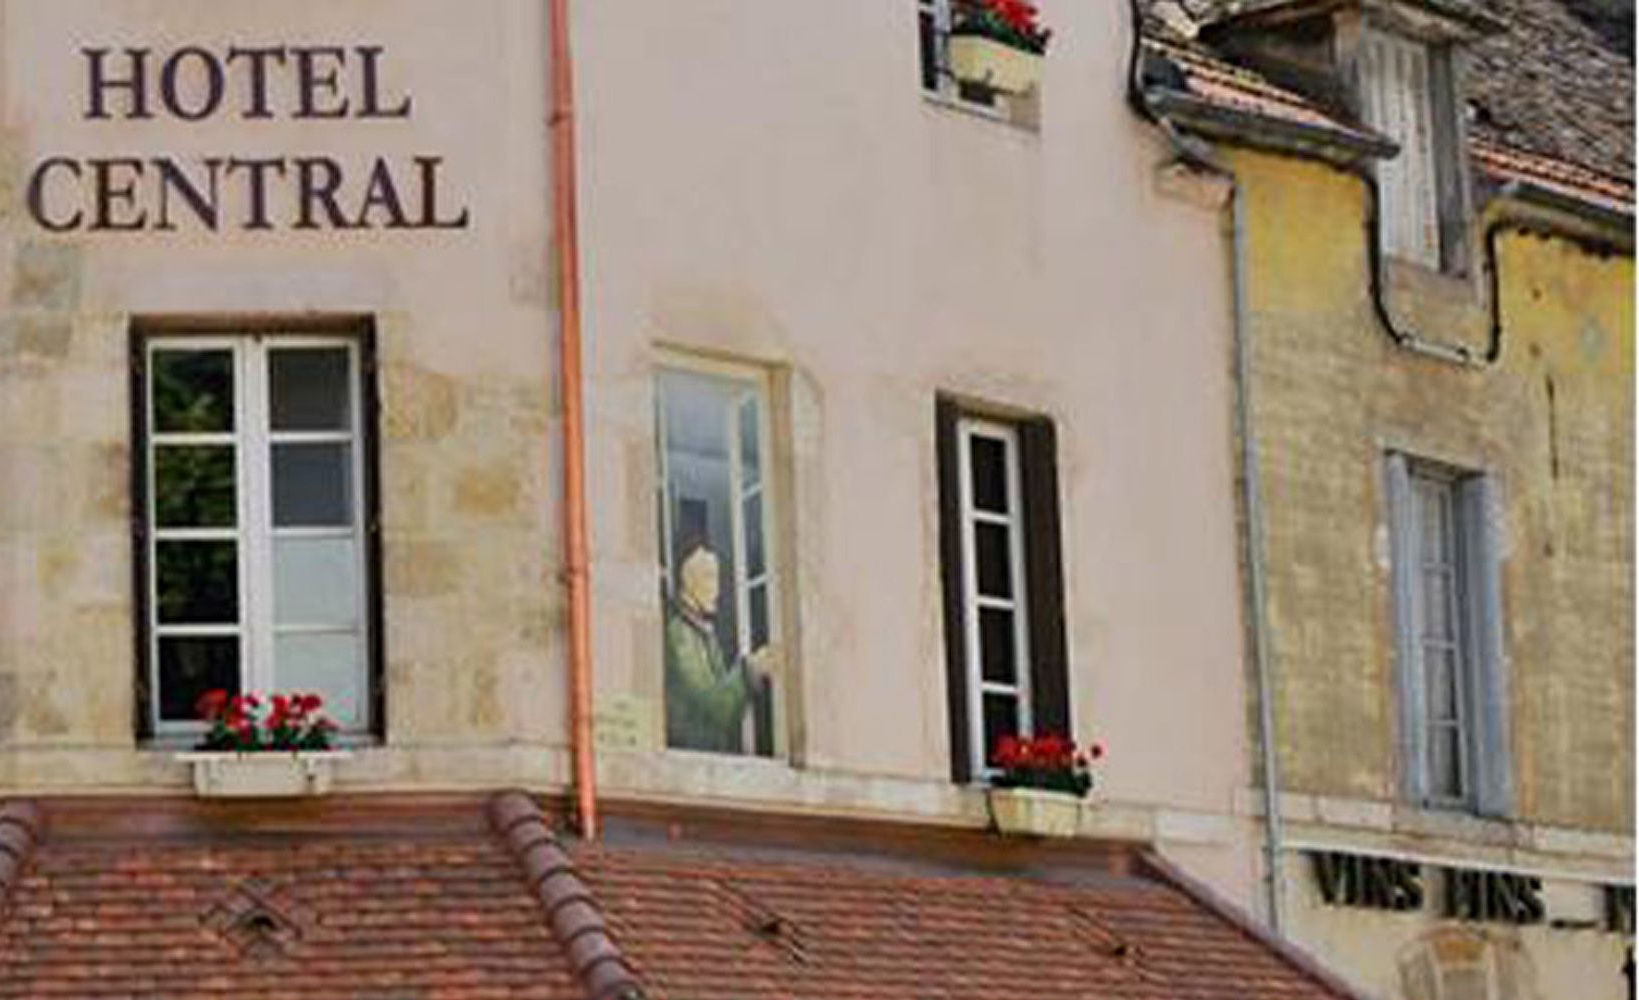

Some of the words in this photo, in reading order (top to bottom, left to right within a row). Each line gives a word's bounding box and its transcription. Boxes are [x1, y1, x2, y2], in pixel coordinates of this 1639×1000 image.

[80, 45, 412, 120] HOTEL
[27, 156, 469, 232] CENTRAL
[1310, 851, 1425, 911] VINS
